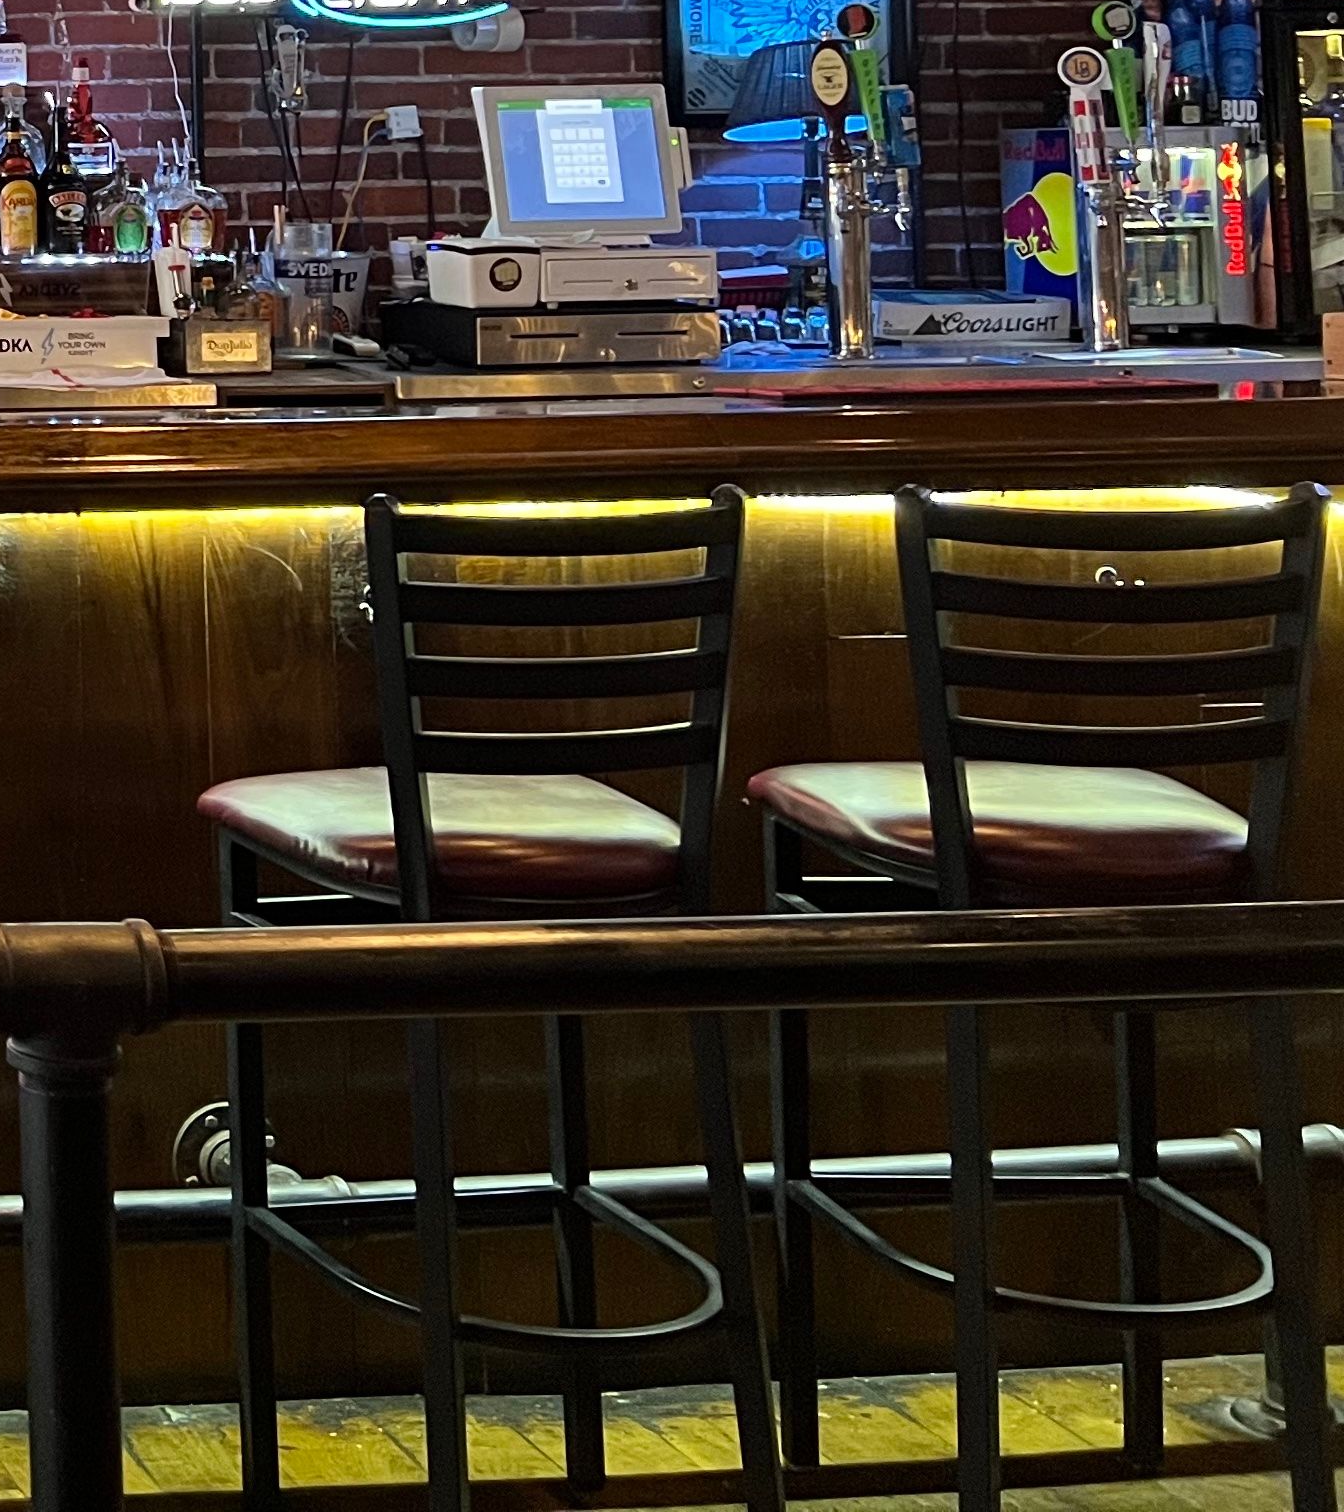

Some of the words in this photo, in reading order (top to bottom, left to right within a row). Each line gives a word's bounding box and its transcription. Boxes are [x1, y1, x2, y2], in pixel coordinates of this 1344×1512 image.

[1221, 100, 1257, 121] BUD
[1006, 316, 1059, 333] LIGHT
[68, 332, 94, 340] BRING
[58, 341, 81, 349] YOUR
[83, 341, 106, 349] OWN
